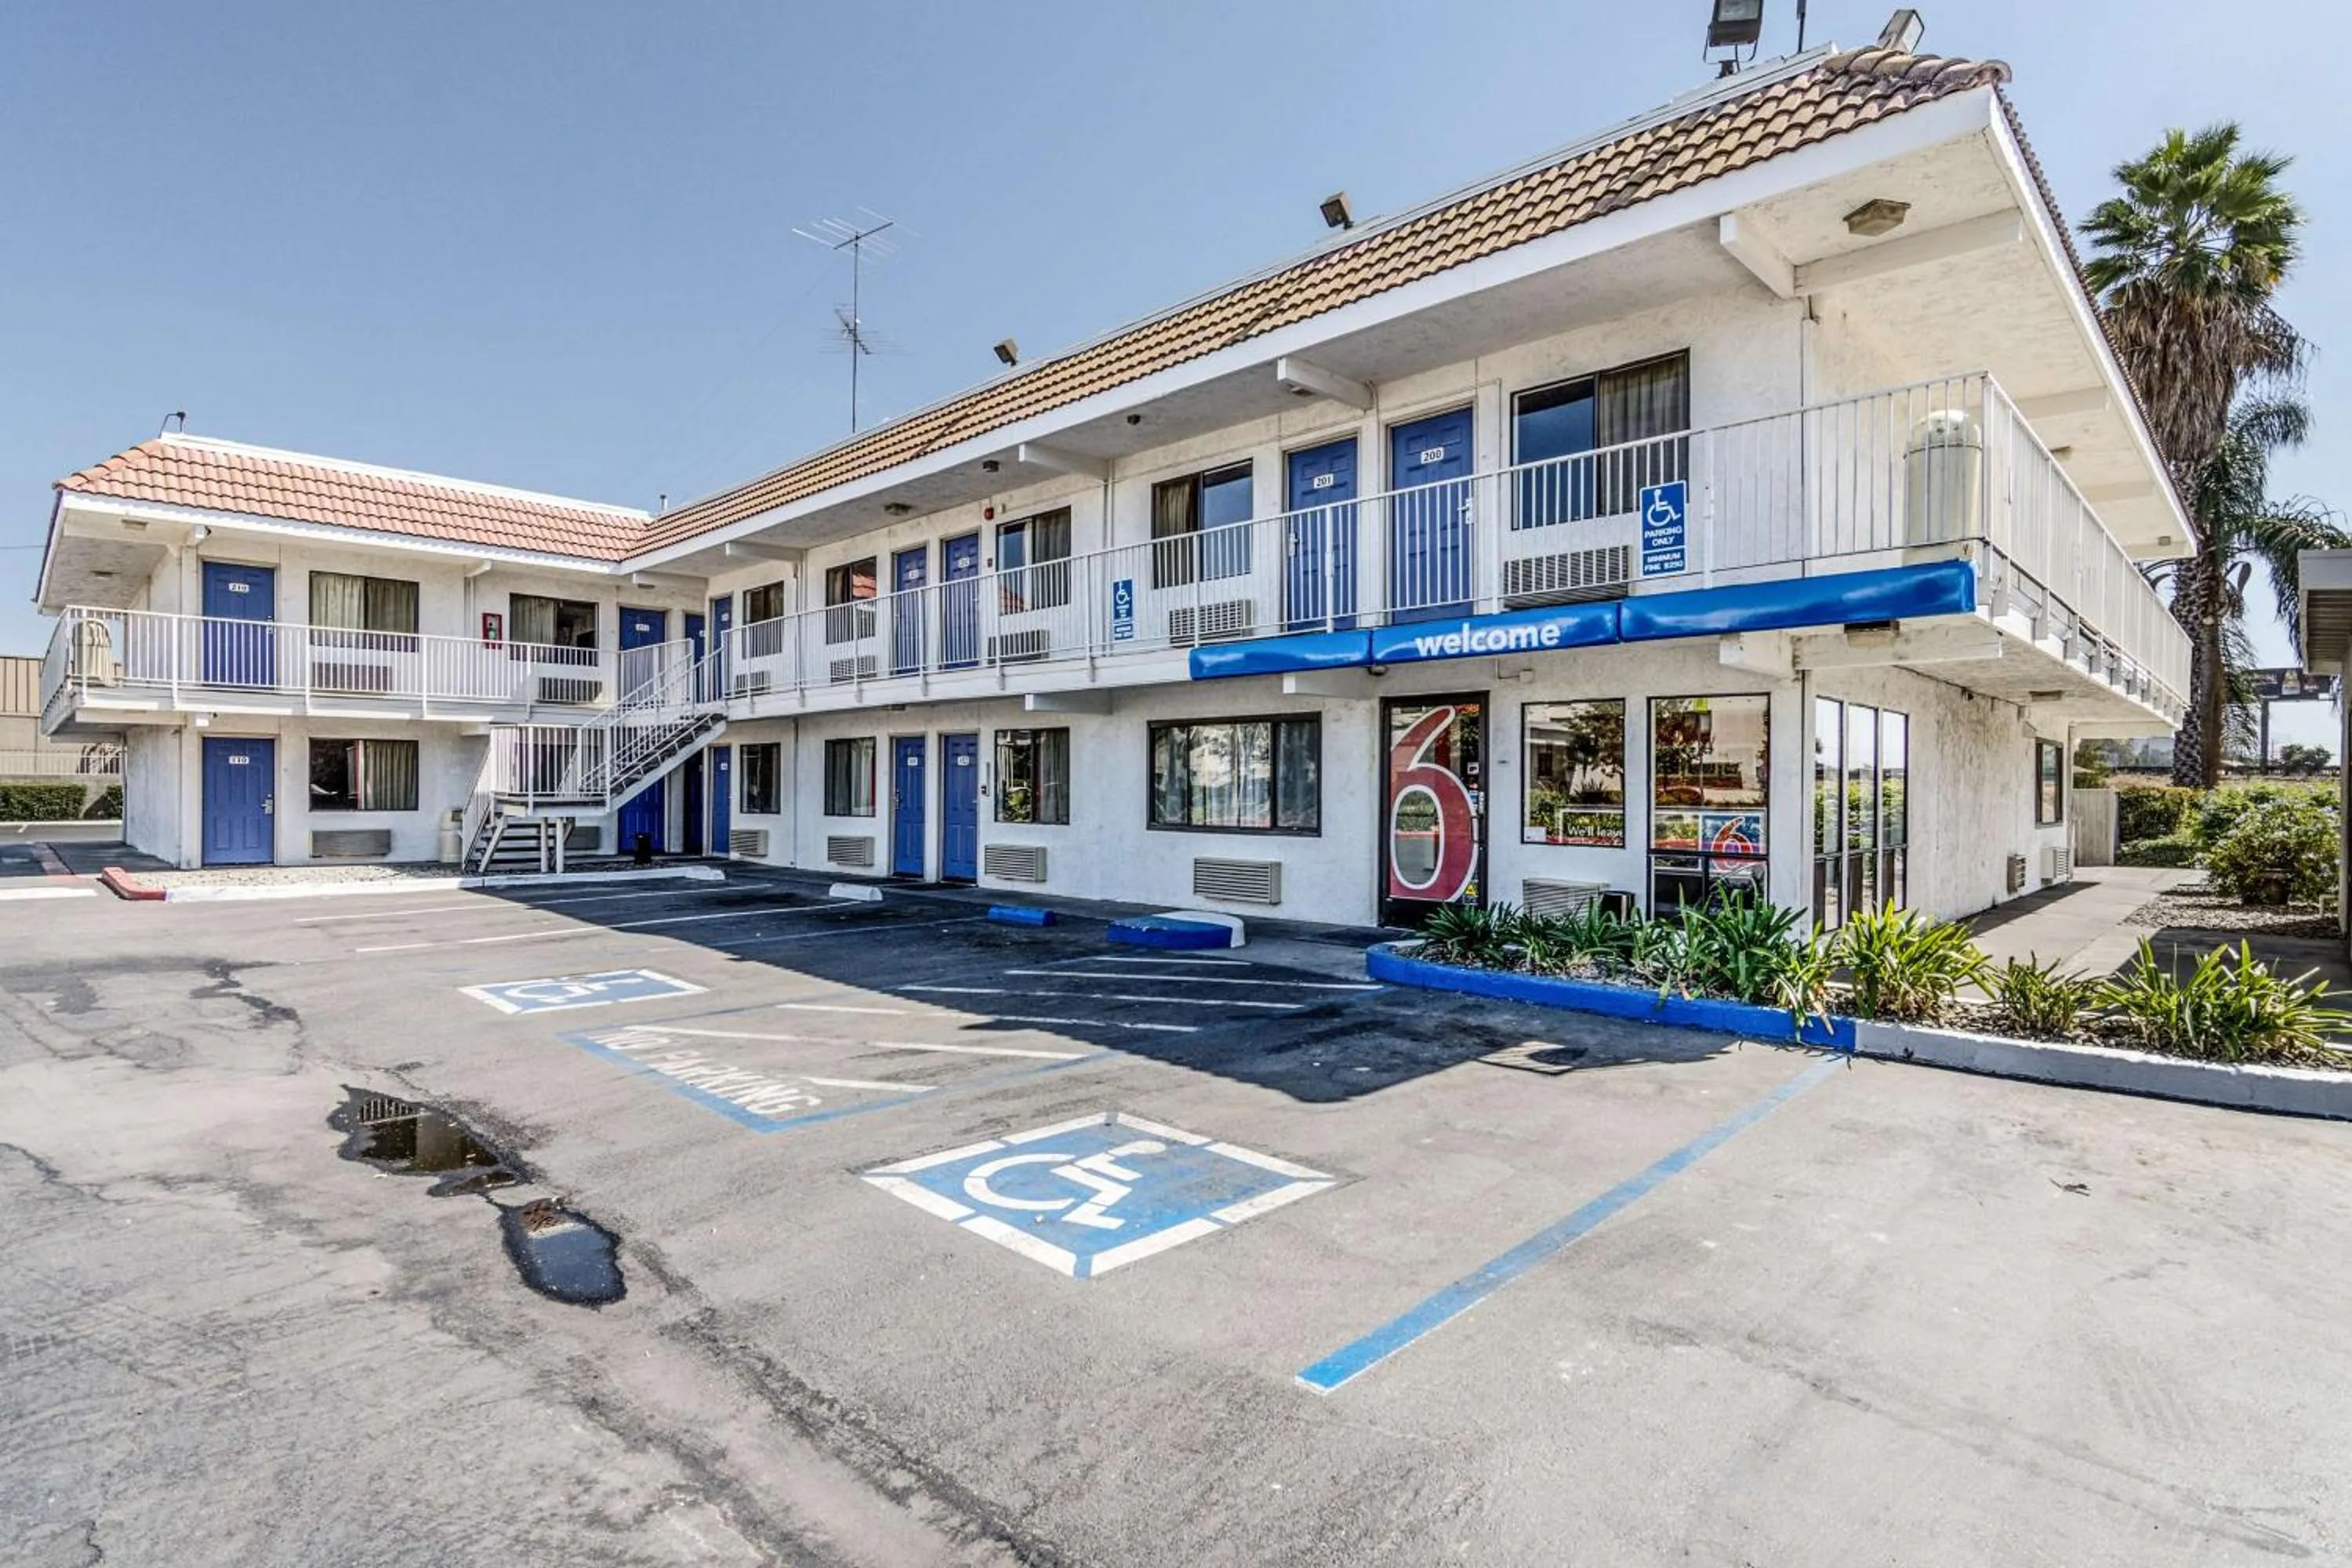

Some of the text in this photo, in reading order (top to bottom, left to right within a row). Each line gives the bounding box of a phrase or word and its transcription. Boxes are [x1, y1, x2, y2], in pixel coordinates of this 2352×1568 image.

[1423, 449, 1442, 461] 200
[1316, 475, 1331, 487] 201
[1644, 525, 1682, 539] PARKING
[1652, 536, 1675, 546] ONLY
[1647, 552, 1681, 563] MINIMUM
[1415, 622, 1561, 657] welcome
[1390, 705, 1479, 902] 6
[1567, 823, 1594, 837] We'll
[1711, 816, 1755, 874] 6
[588, 1030, 822, 1115] NO PARKING
